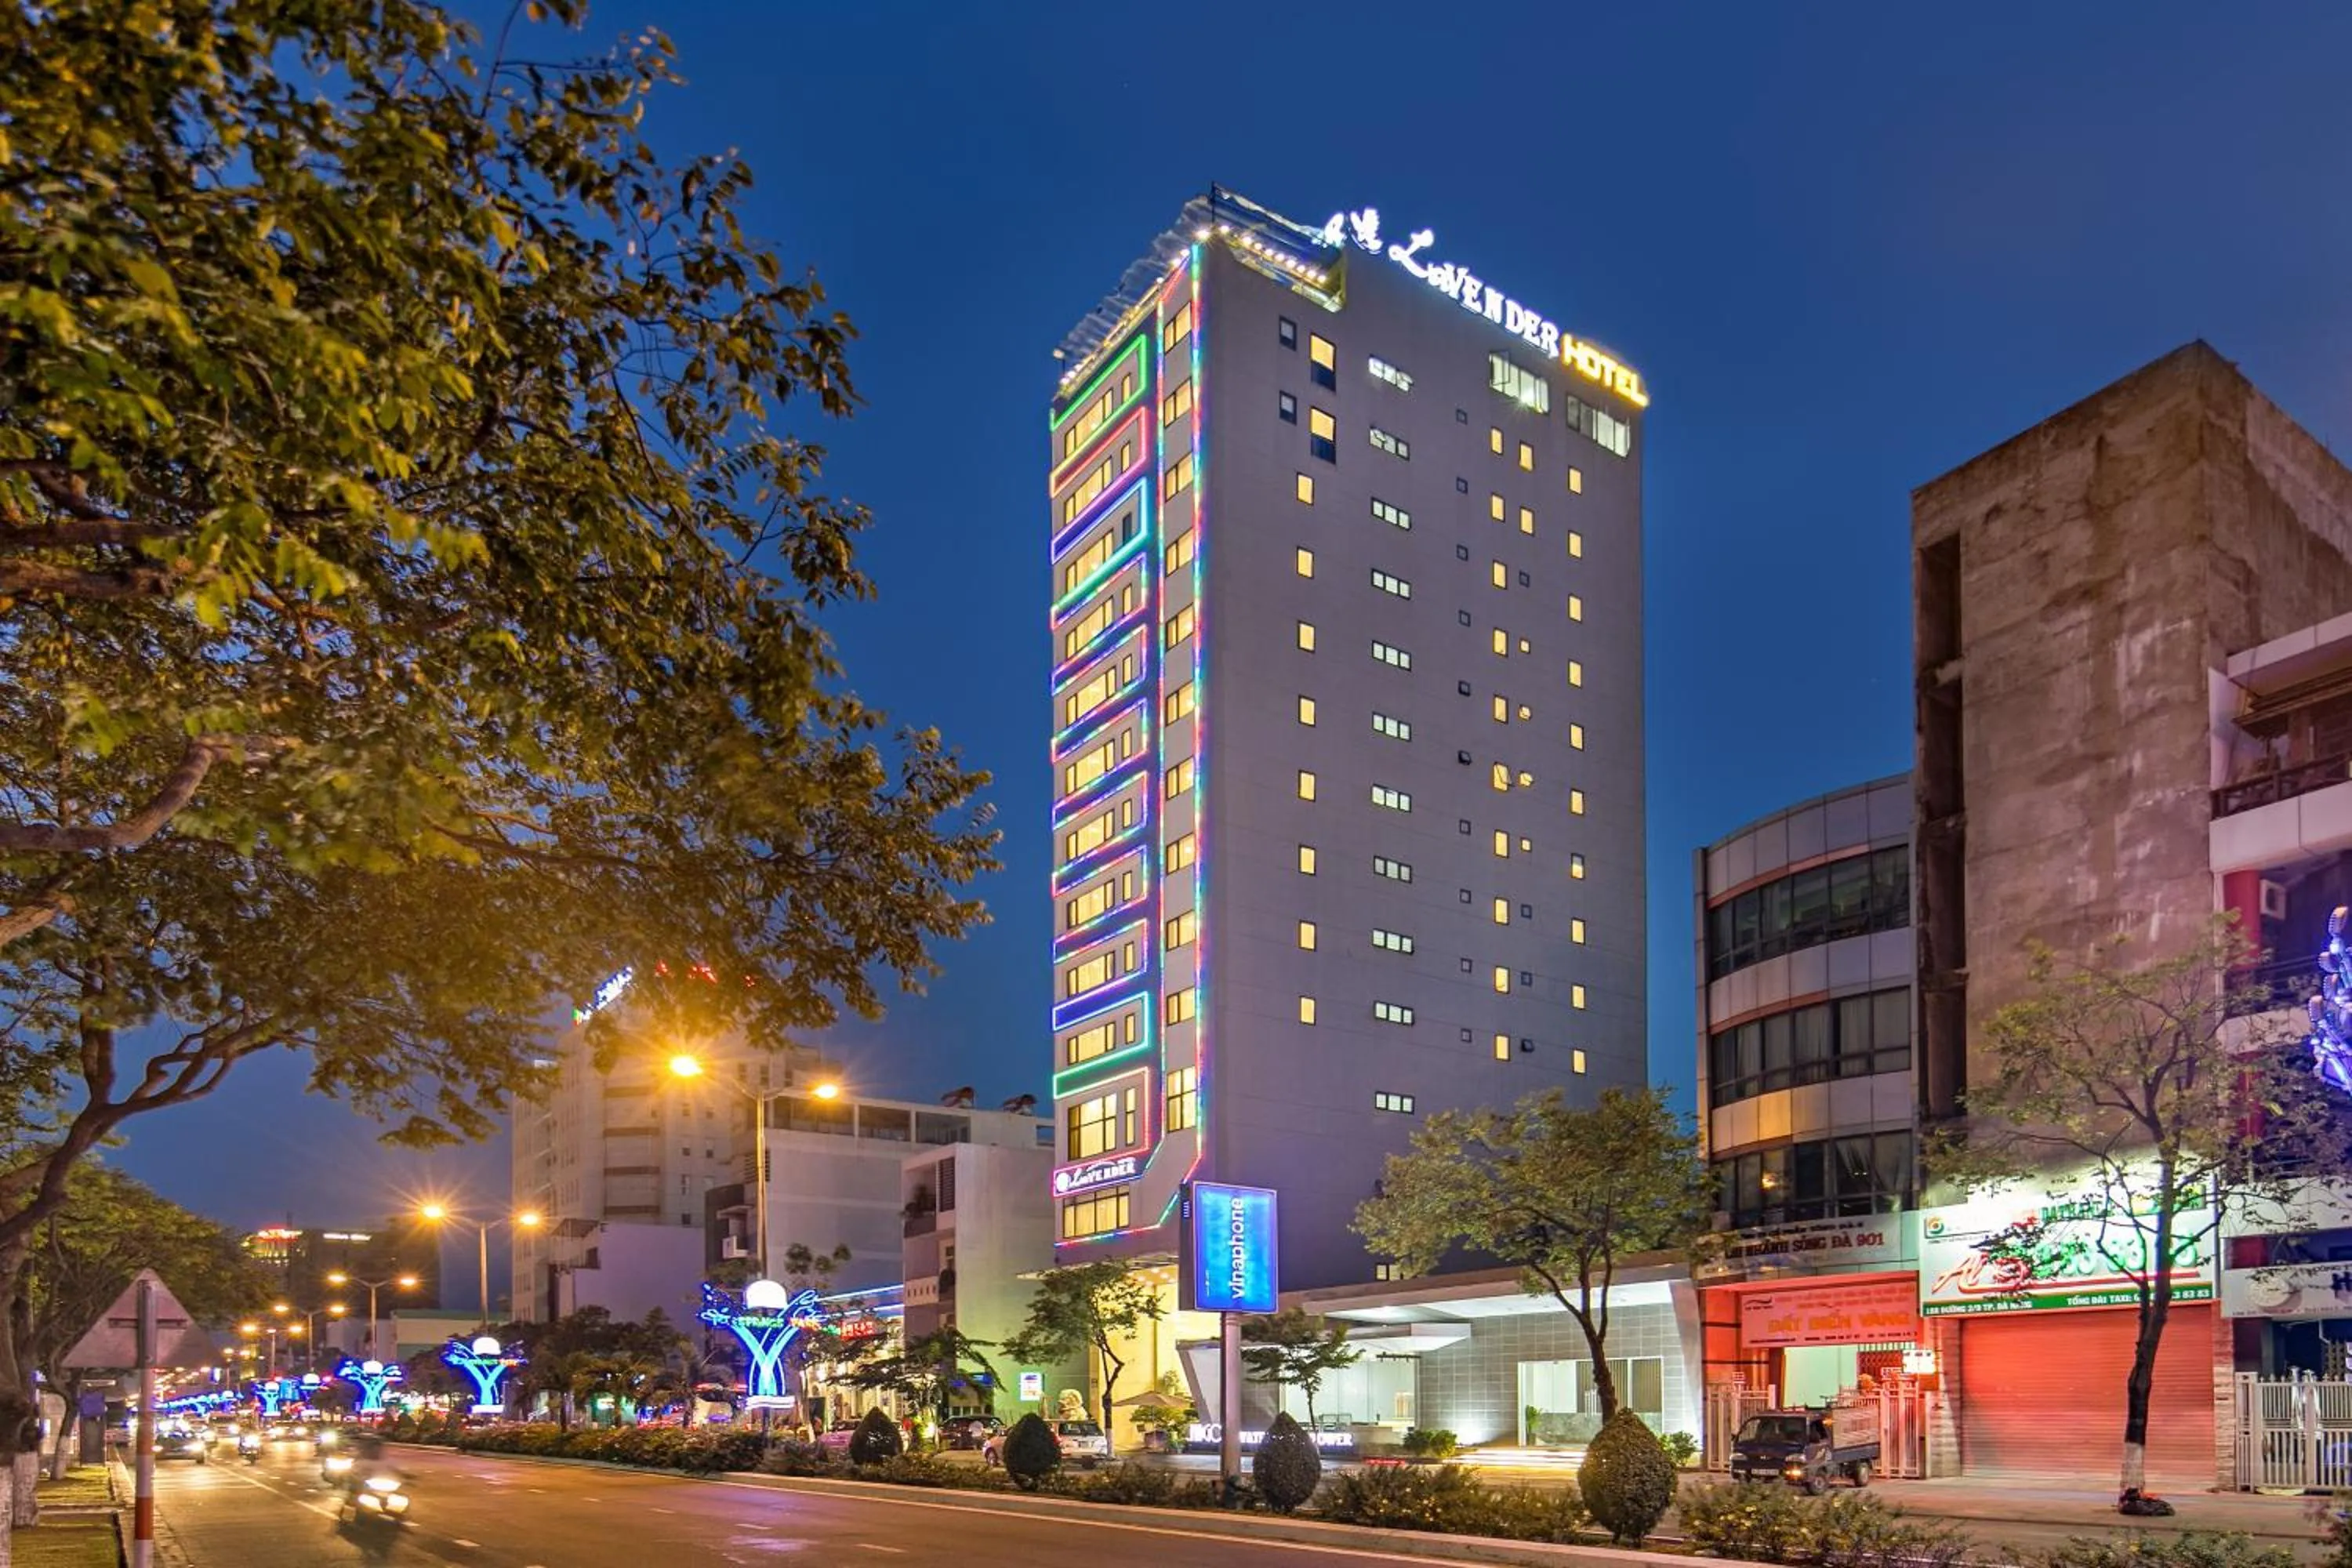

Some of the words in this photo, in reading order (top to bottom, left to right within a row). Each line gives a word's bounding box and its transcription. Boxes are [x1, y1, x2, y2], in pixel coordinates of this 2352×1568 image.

[1562, 332, 1649, 408] HOTEL
[1228, 1197, 1247, 1300] vinaphone
[1792, 1235, 1827, 1252] SÔNG
[1831, 1230, 1853, 1248] ĐÀ
[1857, 1232, 1885, 1247] 901
